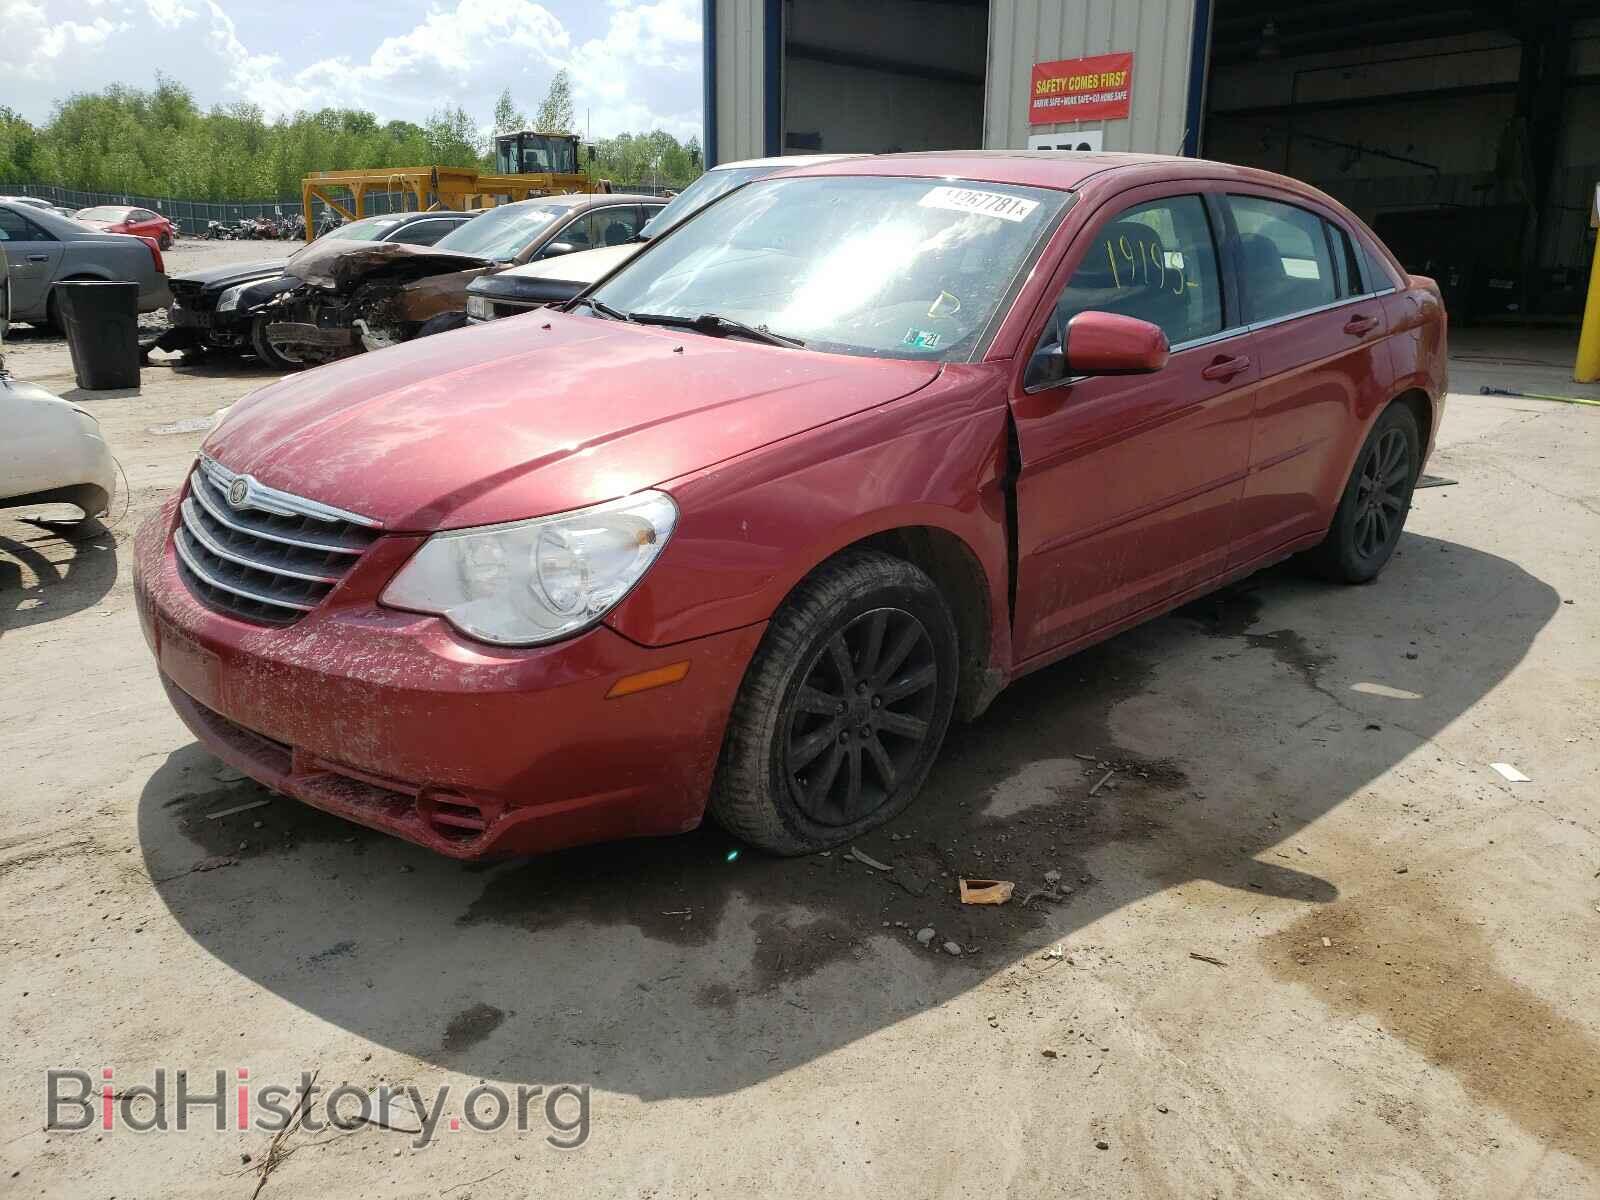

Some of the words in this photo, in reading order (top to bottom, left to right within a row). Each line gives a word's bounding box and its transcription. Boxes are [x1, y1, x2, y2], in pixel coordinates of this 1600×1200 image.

[1036, 79, 1067, 94] SAFETY
[1069, 75, 1098, 91] COMES
[1101, 71, 1127, 87] FIRST
